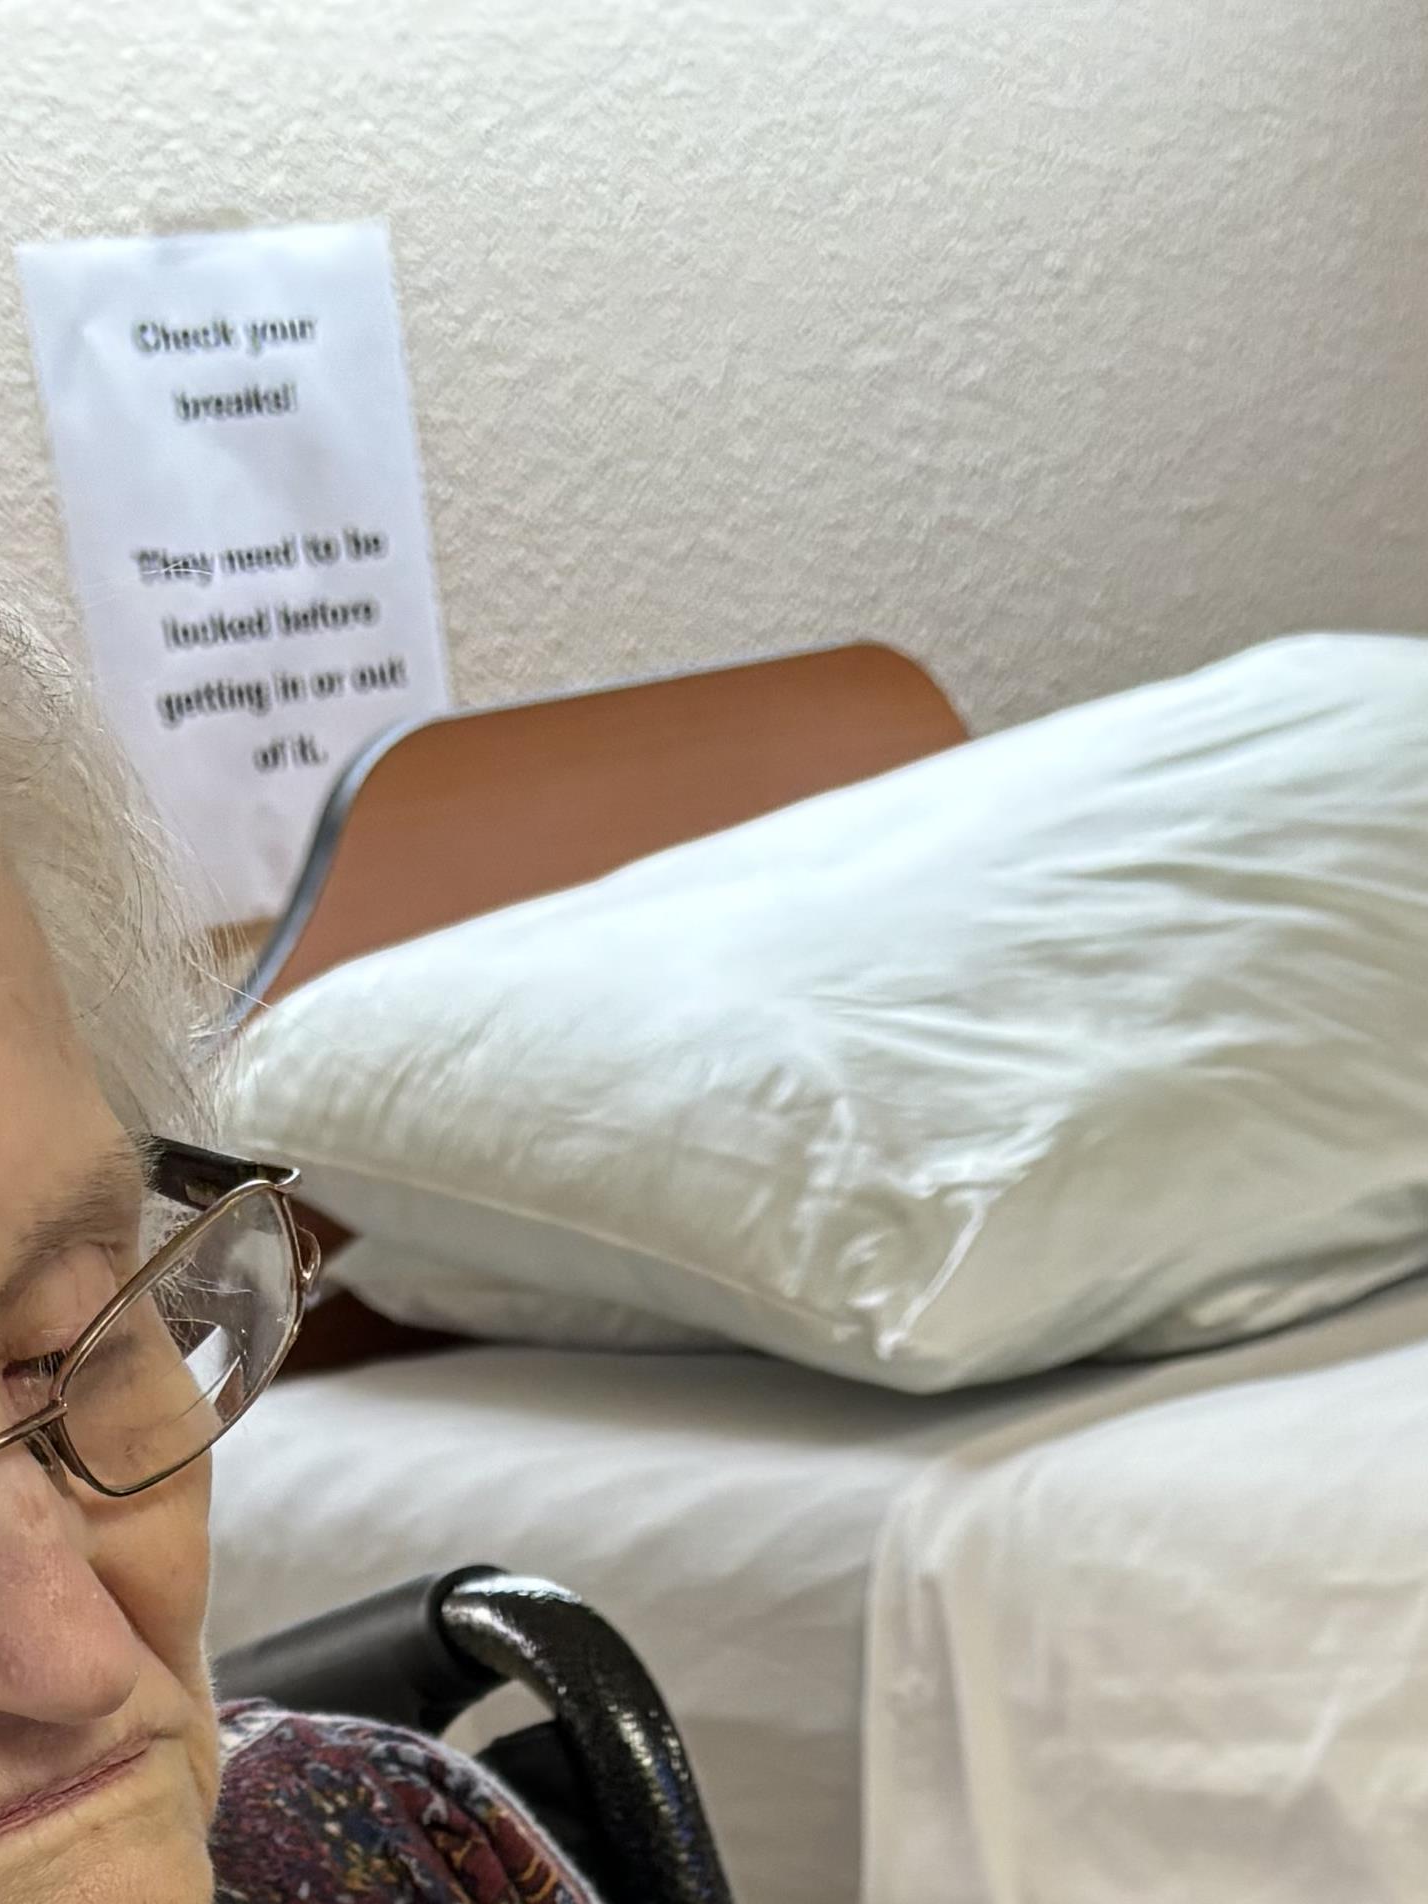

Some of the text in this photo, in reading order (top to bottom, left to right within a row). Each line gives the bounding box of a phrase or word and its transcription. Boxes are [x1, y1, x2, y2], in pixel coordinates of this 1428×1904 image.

[135, 318, 316, 355] Check your
[132, 527, 387, 586] They need to be
[162, 600, 380, 651] locked before
[158, 657, 406, 729] getting in or out
[254, 737, 287, 771] of
